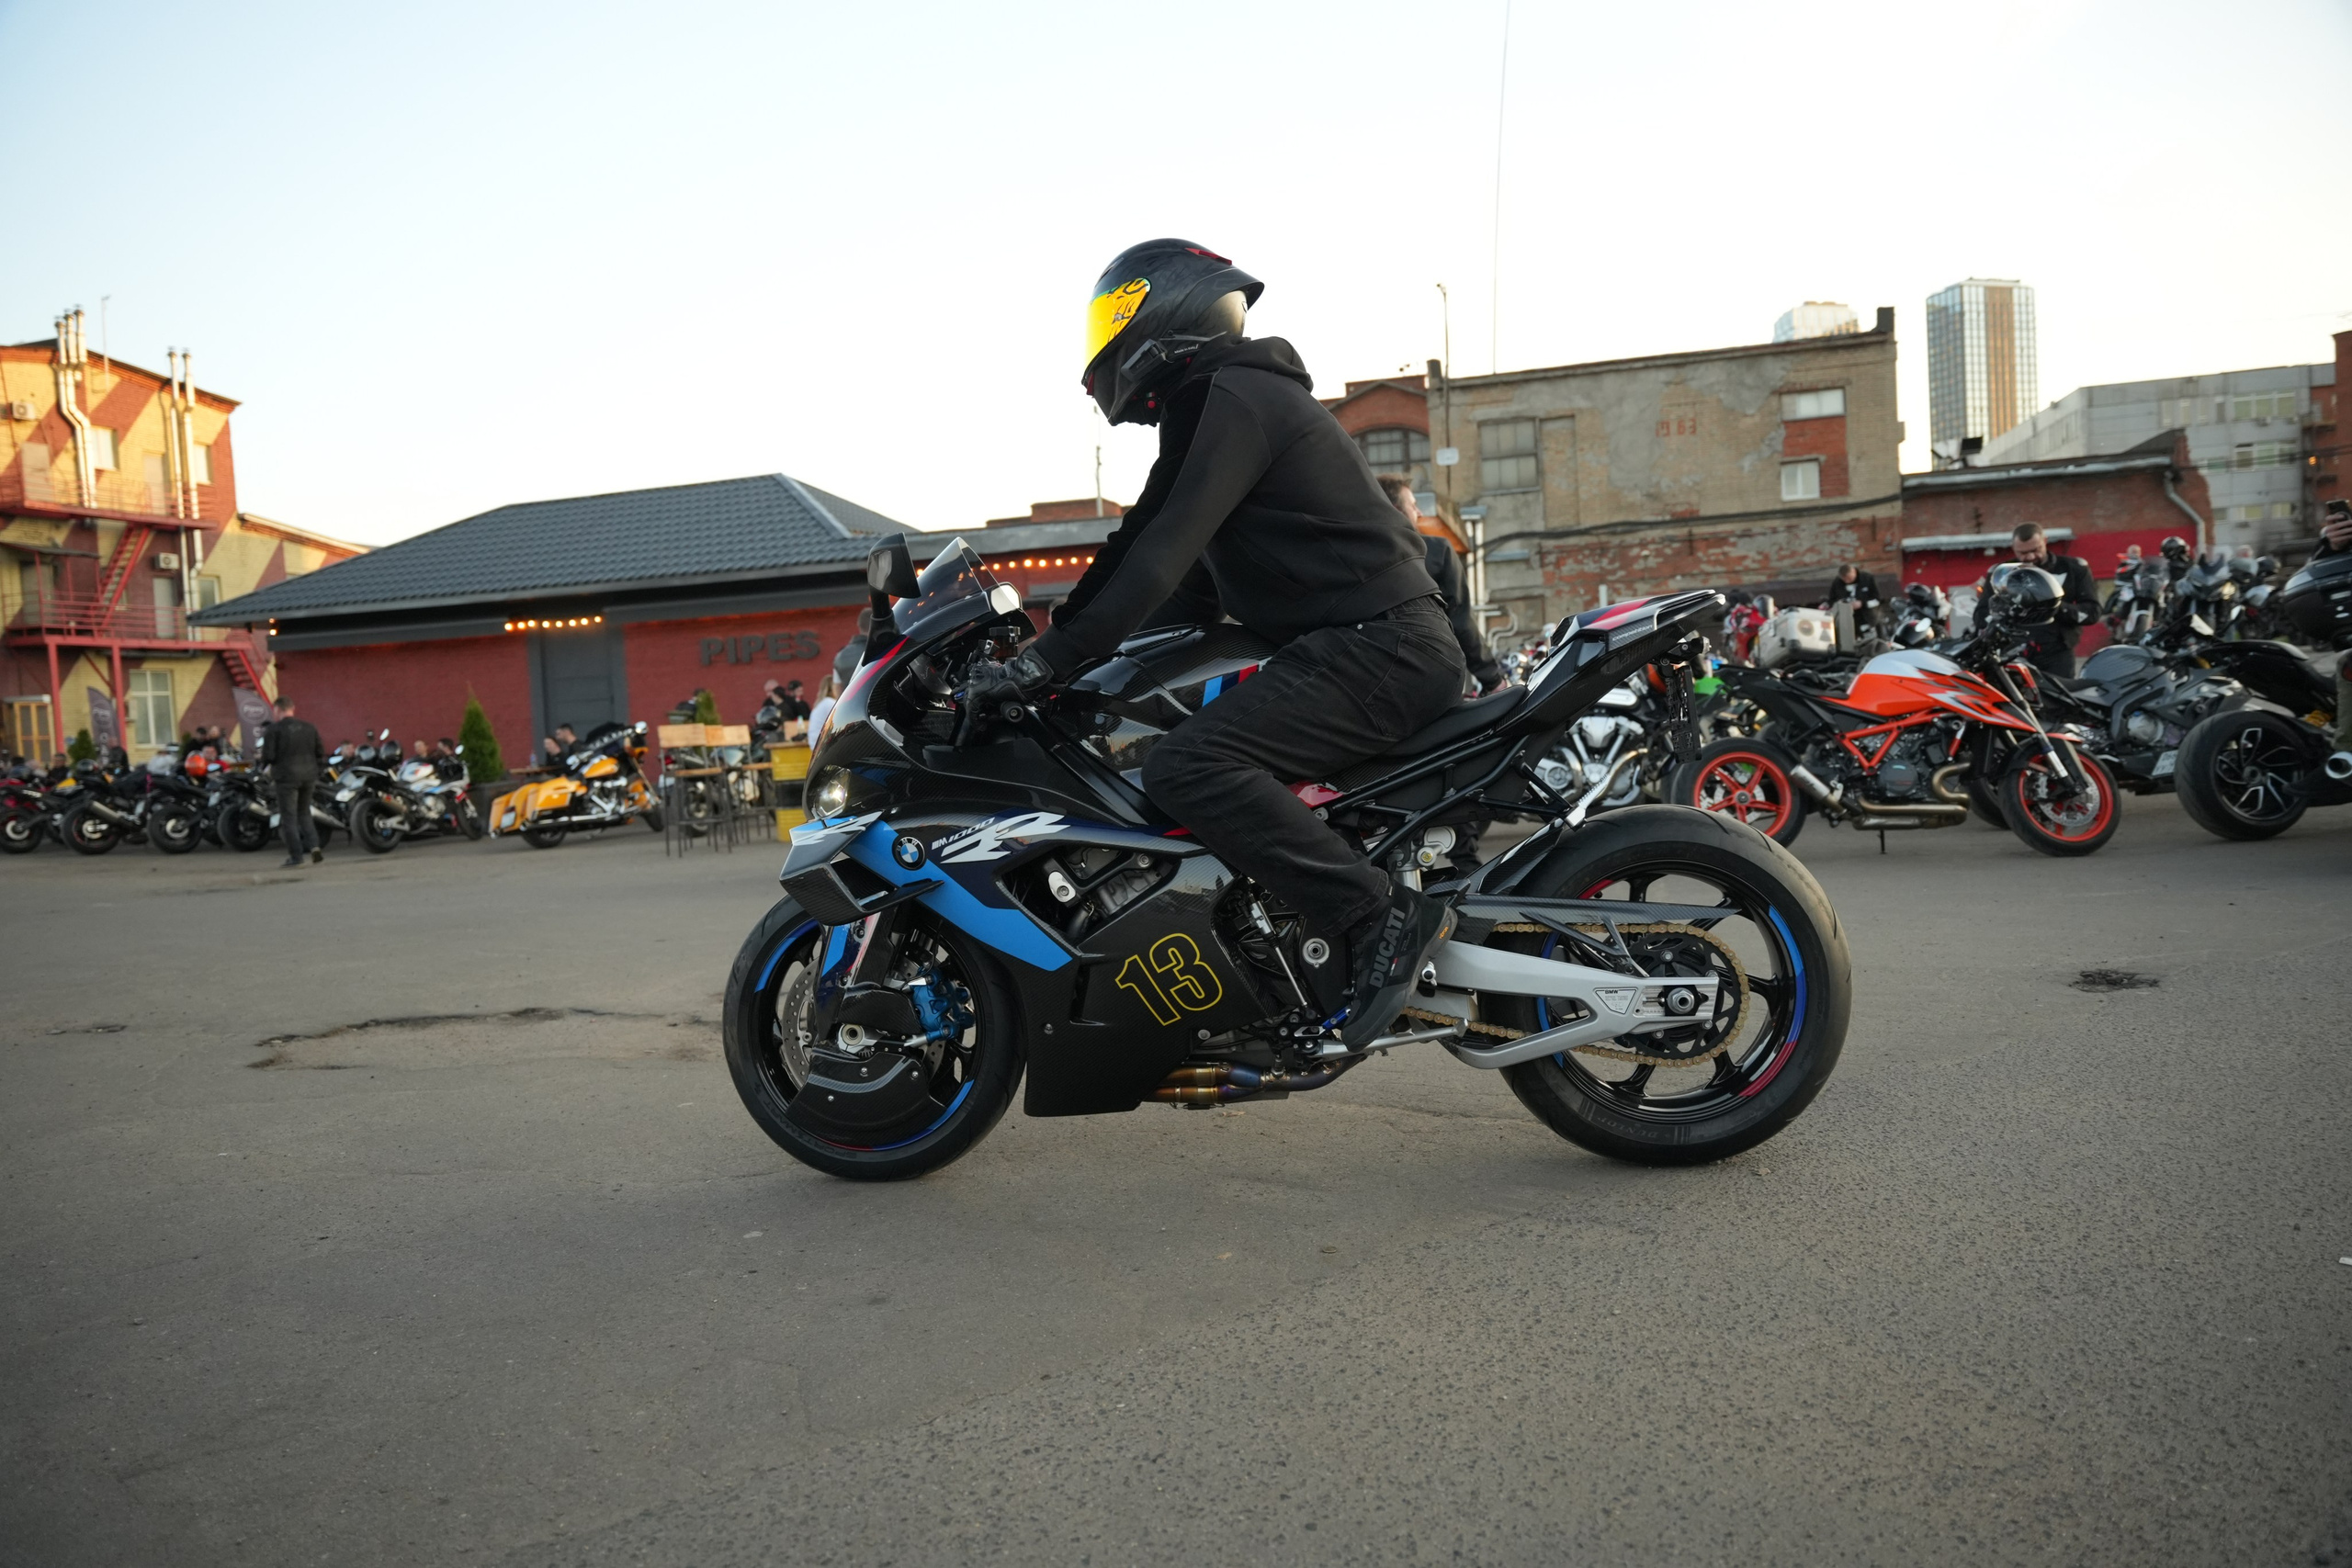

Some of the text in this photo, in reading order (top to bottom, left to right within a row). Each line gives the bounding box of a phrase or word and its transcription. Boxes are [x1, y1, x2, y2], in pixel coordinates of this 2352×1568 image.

[1612, 624, 1654, 641] competition
[701, 630, 820, 666] PIPES
[896, 837, 920, 852] BMW
[1369, 907, 1406, 988] DUCATI
[1115, 933, 1223, 1026] 13
[1597, 1116, 1657, 1138] DUNLOP
